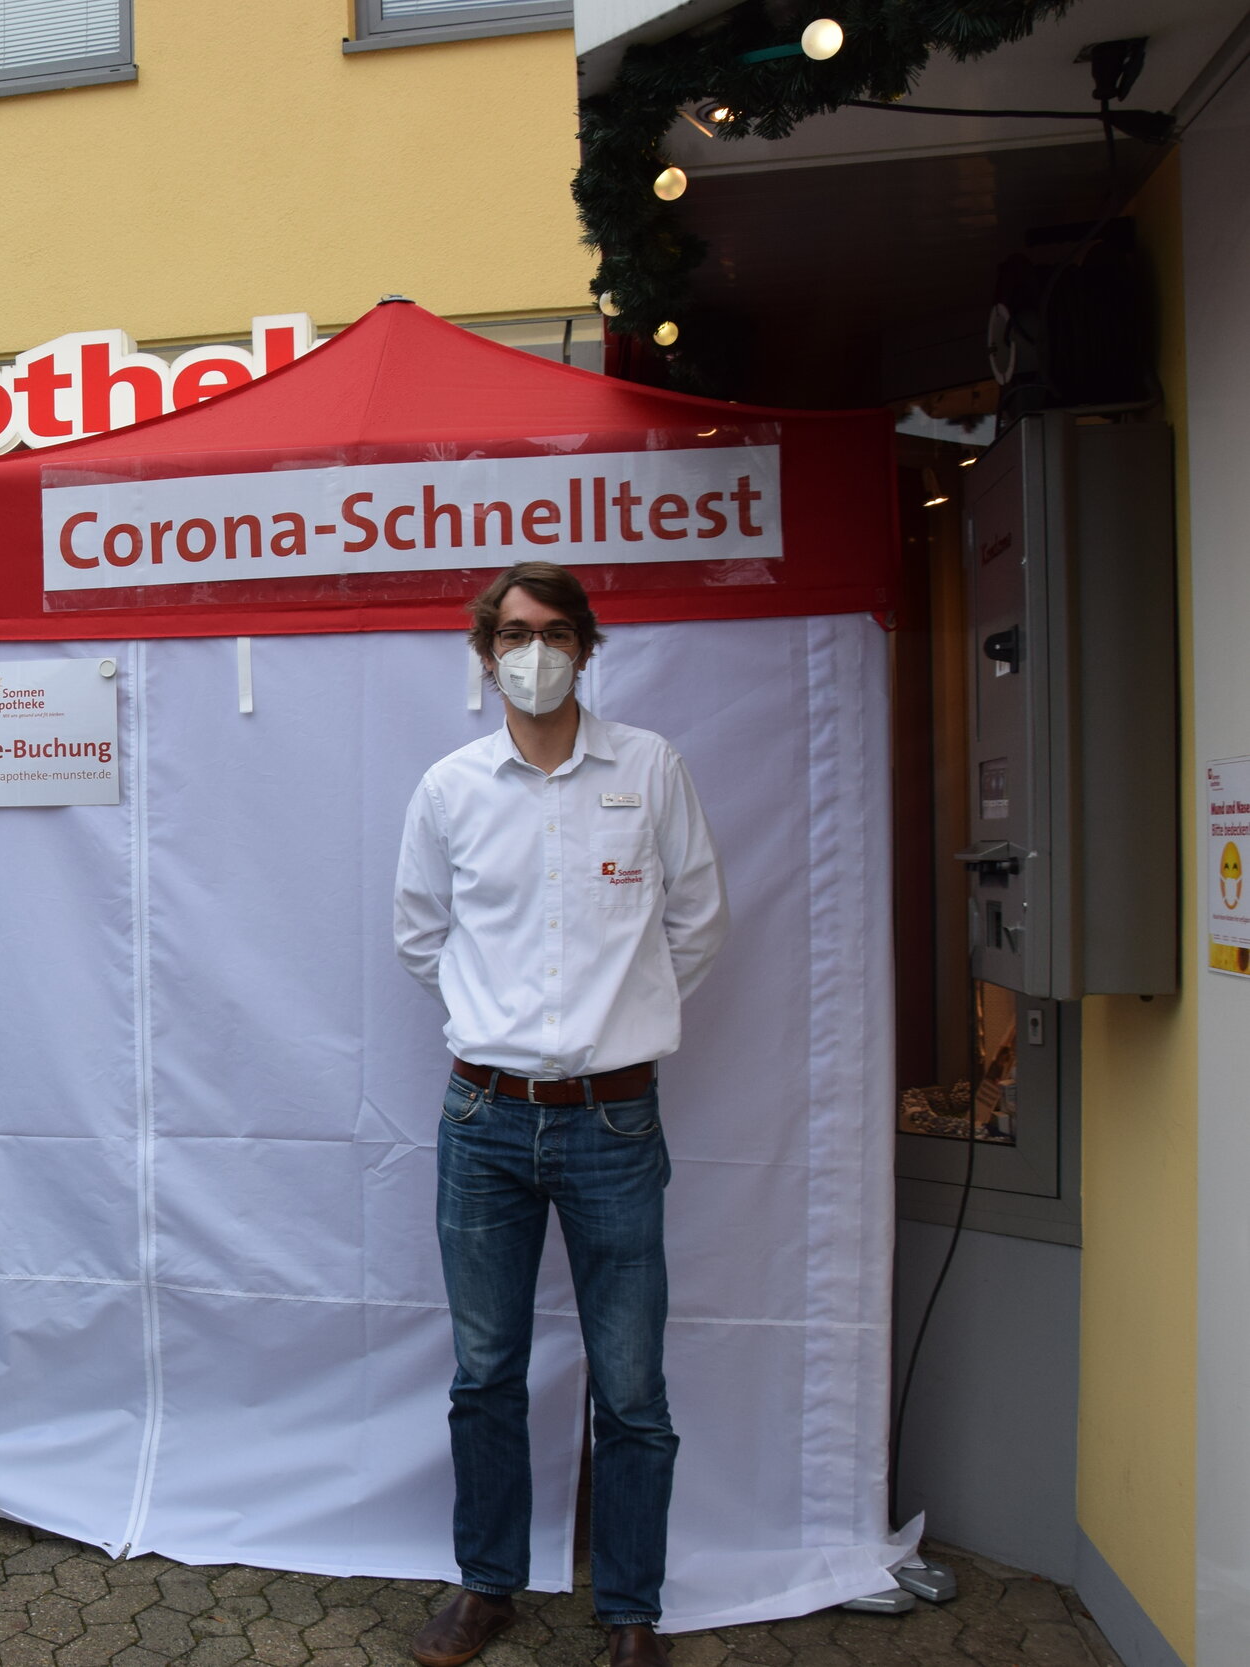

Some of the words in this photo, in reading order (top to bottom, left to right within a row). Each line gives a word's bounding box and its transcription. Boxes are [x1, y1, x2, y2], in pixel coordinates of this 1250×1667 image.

[58, 475, 763, 570] Corona-Schnelltest
[2, 688, 45, 699] Sonnen
[610, 876, 643, 885] Apotheke
